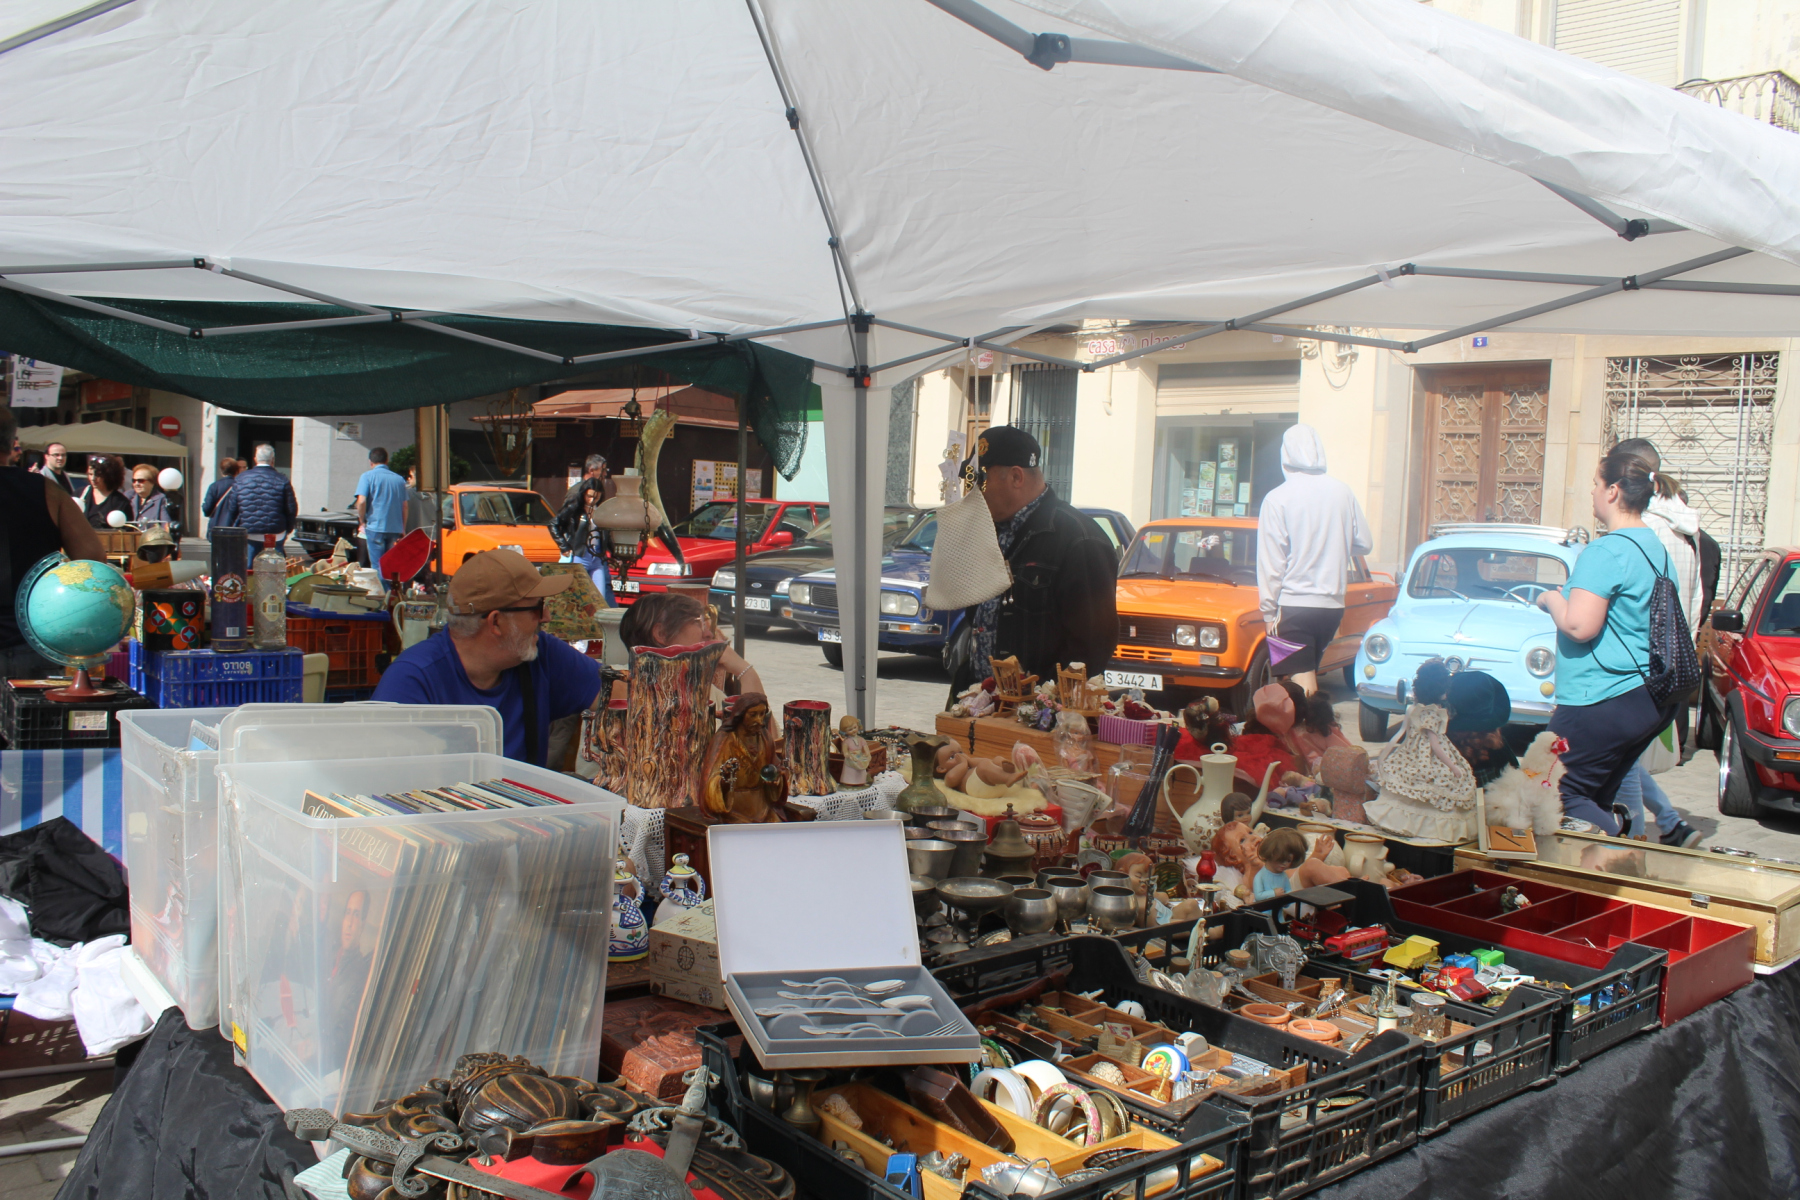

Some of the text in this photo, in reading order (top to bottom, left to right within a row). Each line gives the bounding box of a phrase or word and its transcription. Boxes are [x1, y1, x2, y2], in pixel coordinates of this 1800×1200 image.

[1088, 340, 1116, 354] casa
[1476, 337, 1483, 347] 3
[823, 629, 832, 640] CS
[222, 661, 251, 670] BOLLO
[1105, 672, 1158, 688] S 3442 A
